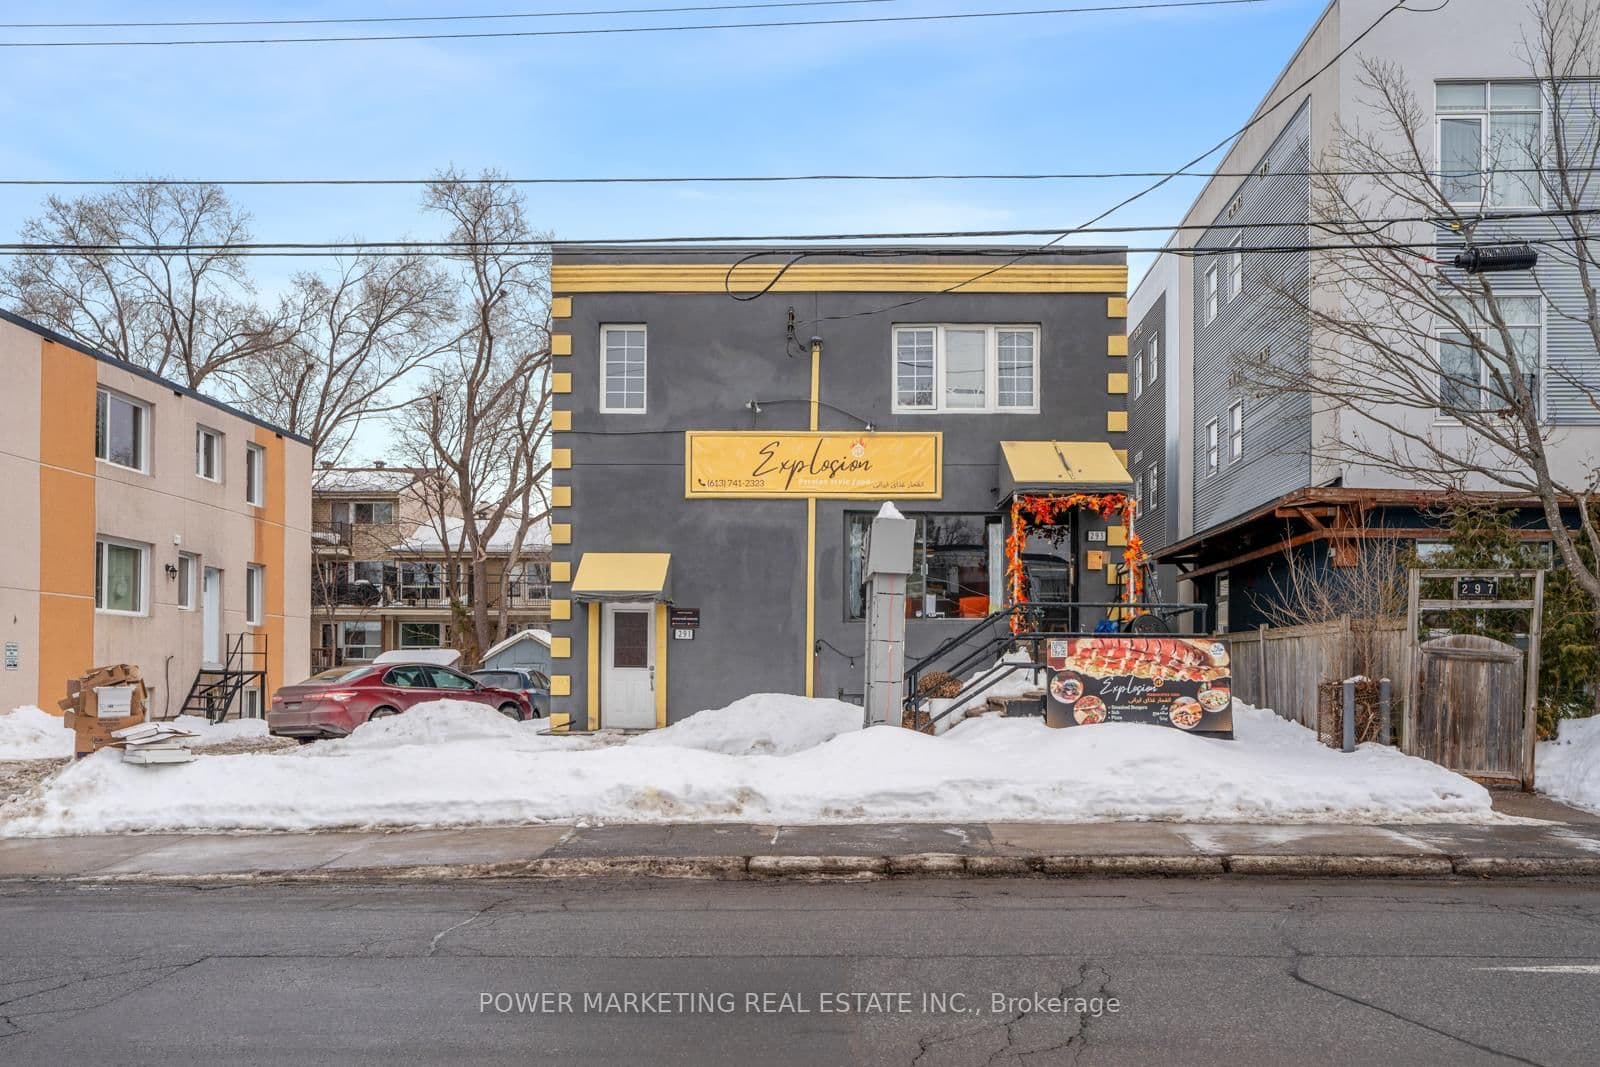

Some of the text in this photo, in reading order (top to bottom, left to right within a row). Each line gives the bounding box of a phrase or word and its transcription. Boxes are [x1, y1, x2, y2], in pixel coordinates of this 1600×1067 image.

[752, 438, 873, 490] Explosion
[707, 479, 765, 488] (613) 741-2323
[1090, 532, 1104, 540] 293
[1461, 583, 1494, 594] 297
[677, 630, 692, 638] 291
[1100, 676, 1157, 701] Explosion
